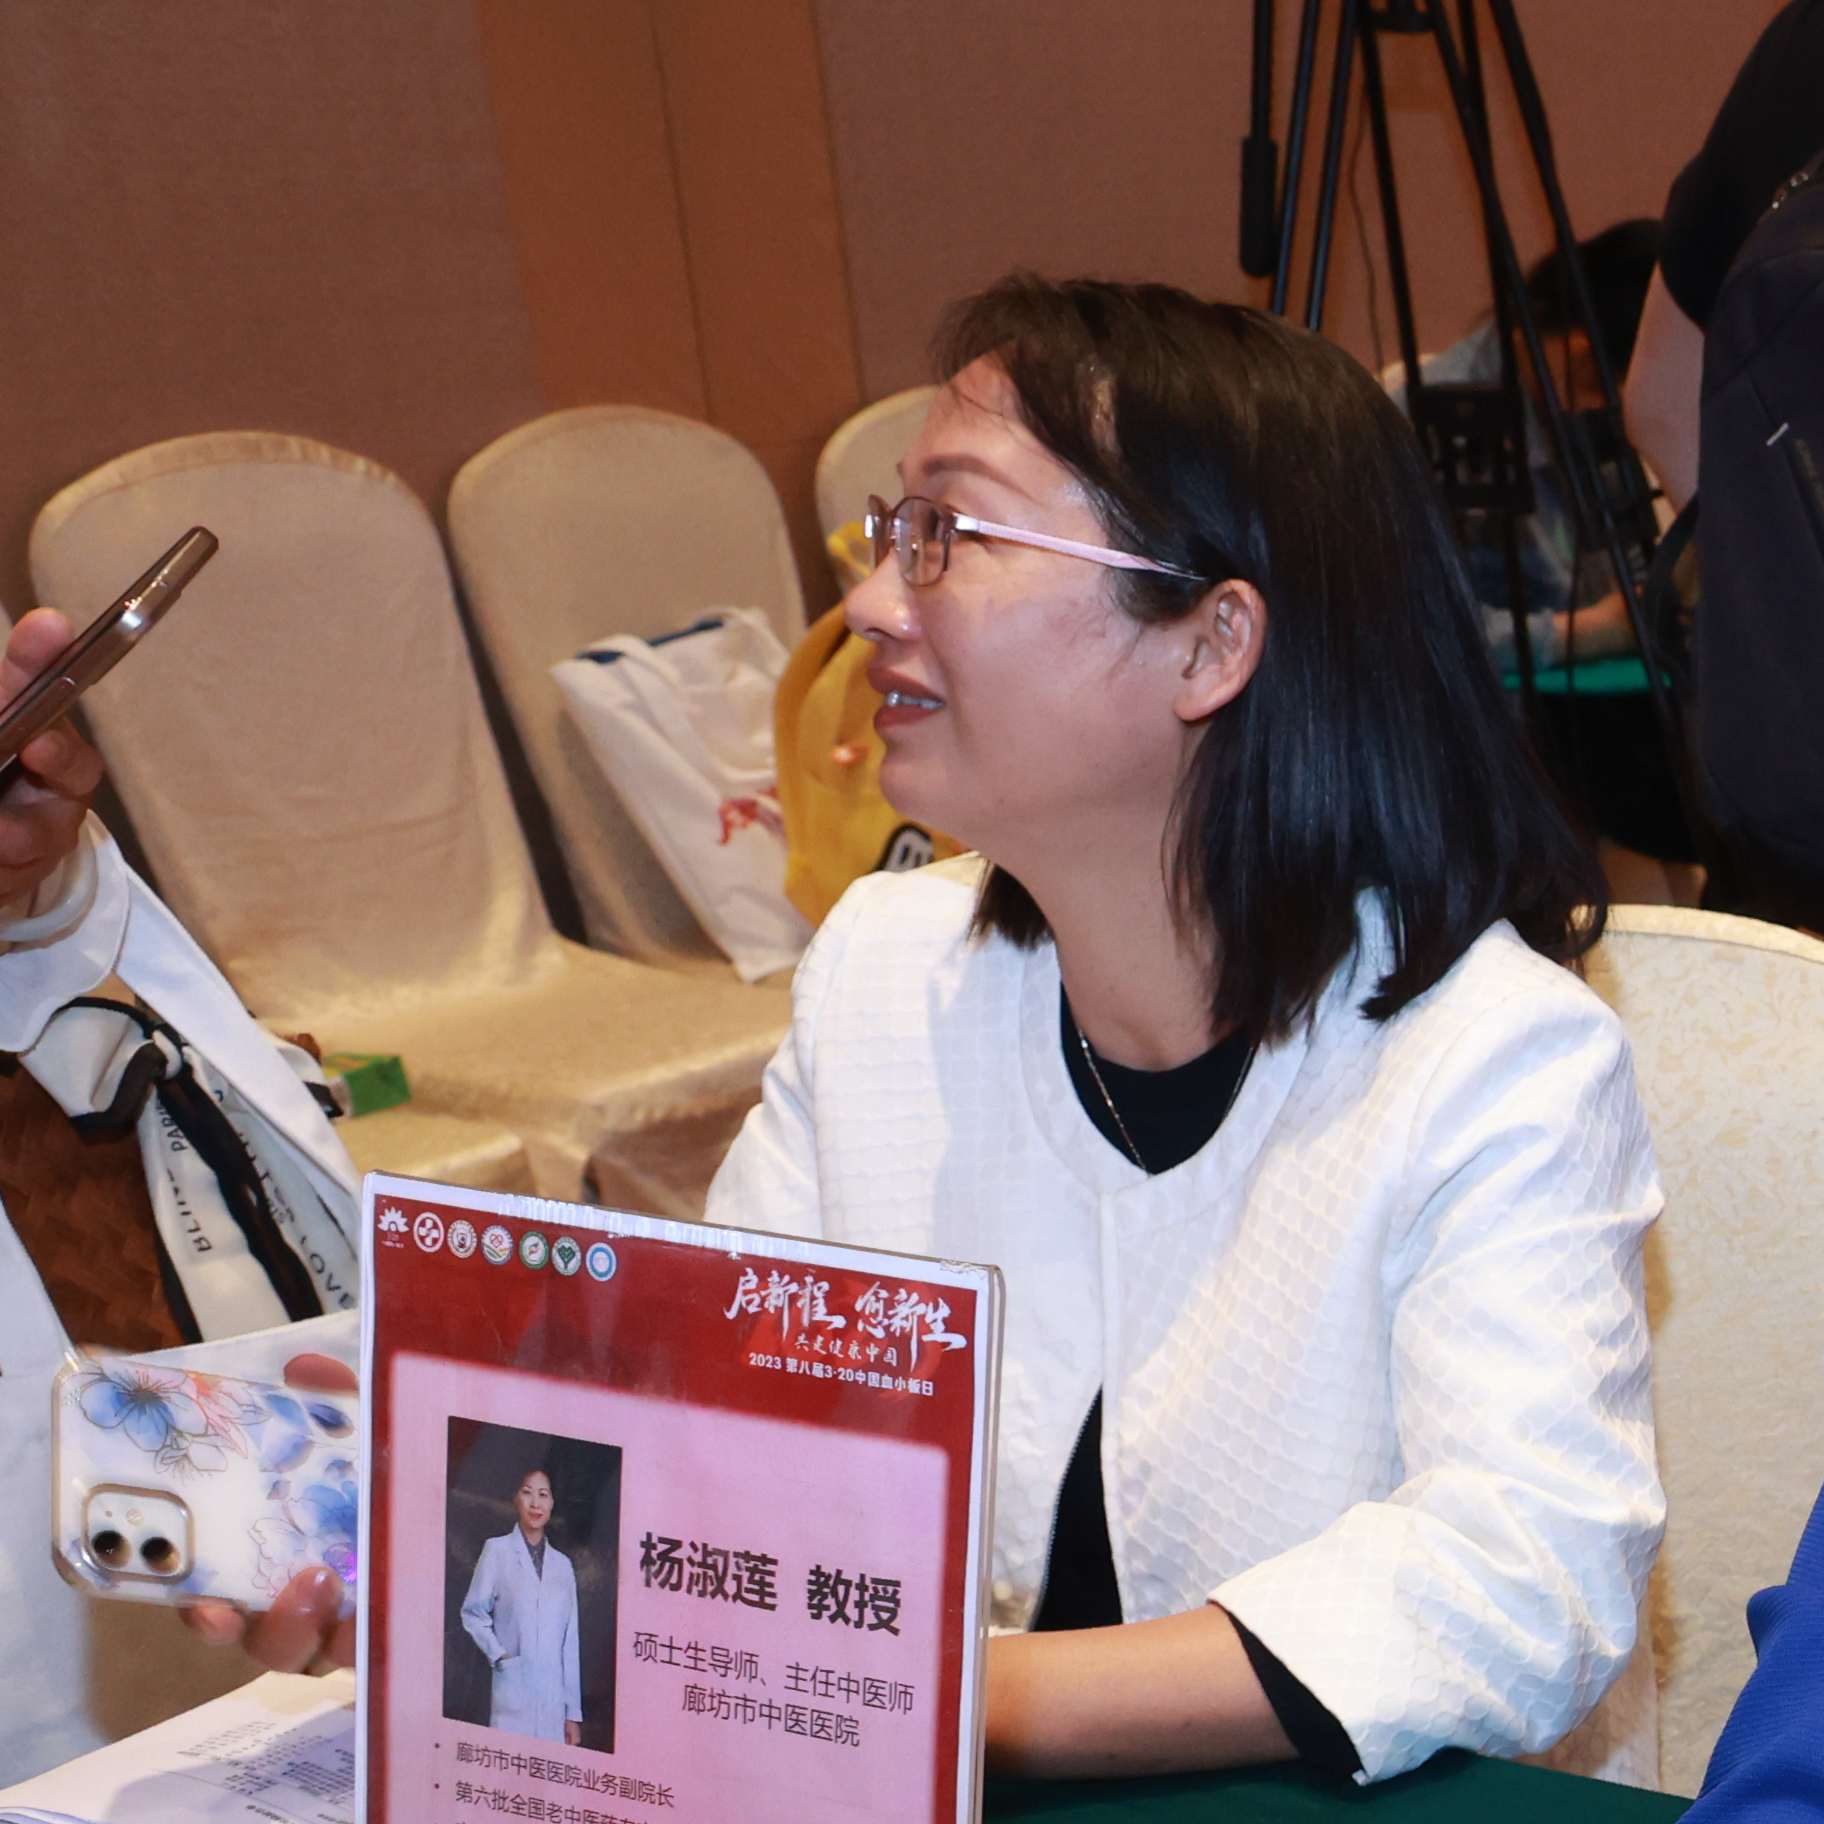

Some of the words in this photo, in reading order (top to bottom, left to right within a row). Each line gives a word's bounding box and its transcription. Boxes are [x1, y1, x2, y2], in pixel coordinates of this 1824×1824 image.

[748, 1352, 782, 1371] 2023
[639, 1533, 779, 1612] 杨淑莲
[806, 1564, 902, 1636] 教授
[632, 1630, 914, 1716] 硕士生导师、主任中医师
[681, 1684, 860, 1748] 廊坊市中医医院
[456, 1741, 675, 1809] 廊坊市中医医院业务副院长
